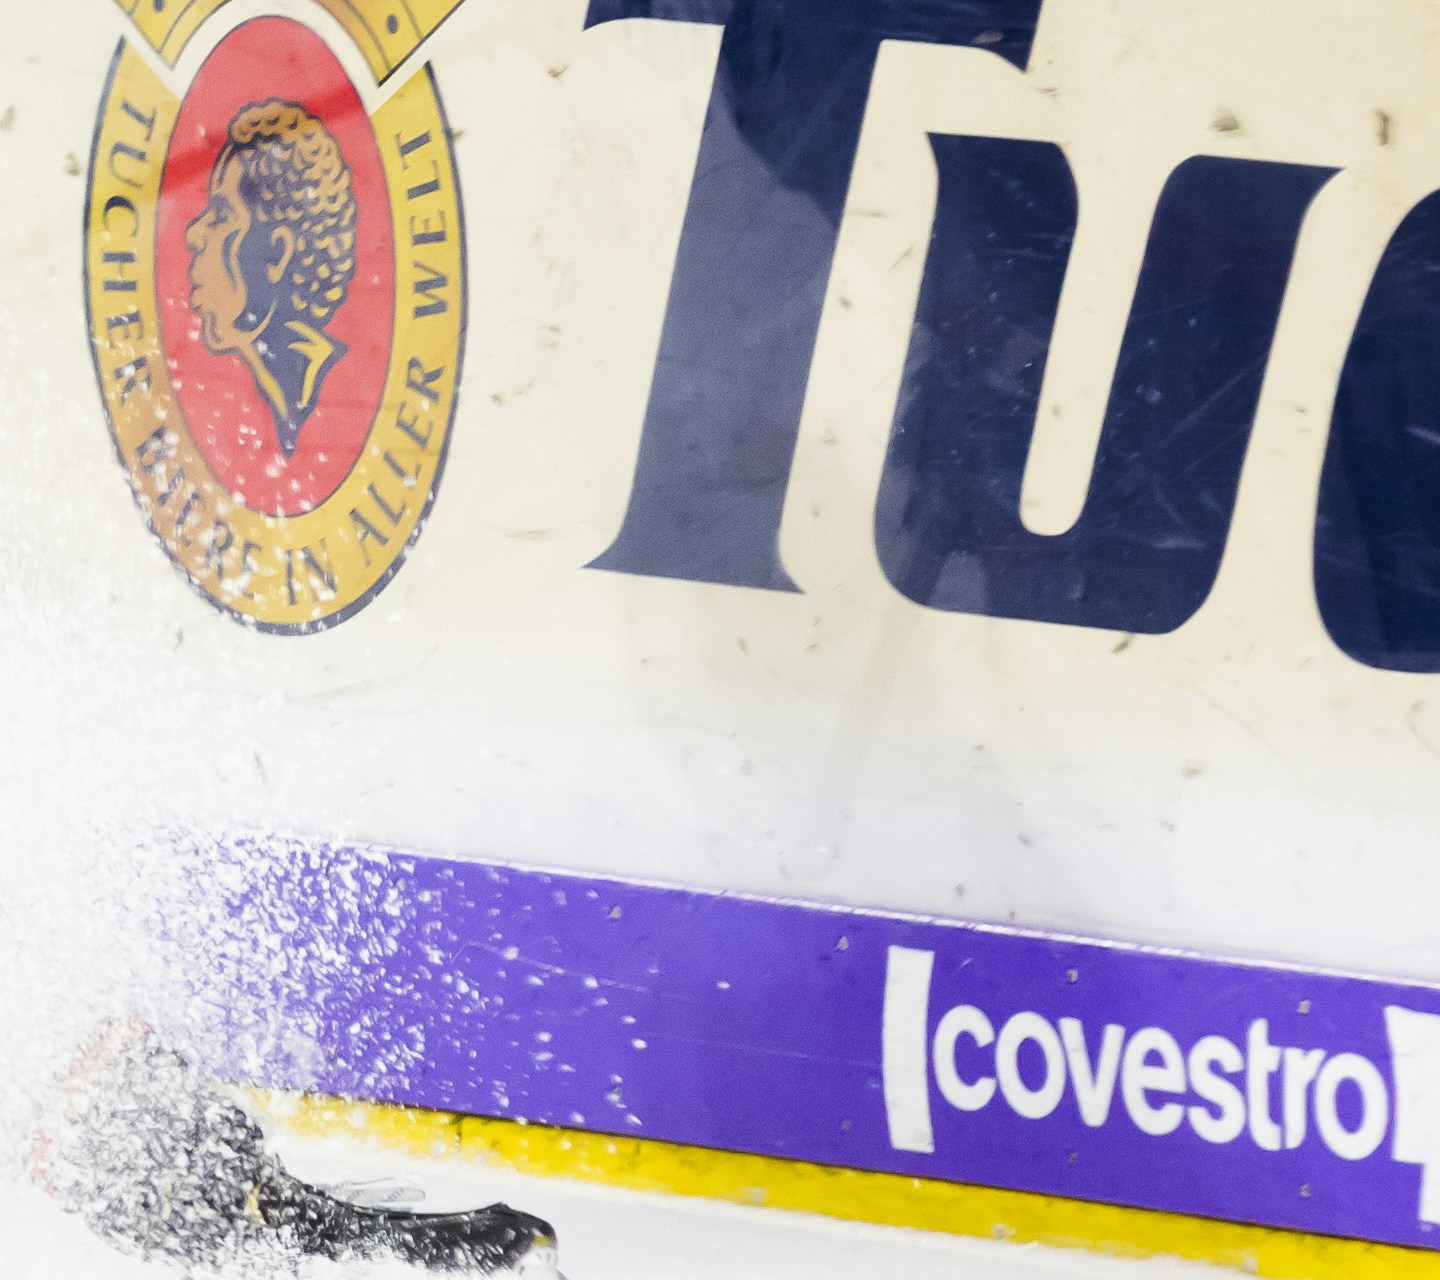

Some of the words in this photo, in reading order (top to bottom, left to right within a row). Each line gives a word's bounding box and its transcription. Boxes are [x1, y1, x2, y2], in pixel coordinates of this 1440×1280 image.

[101, 97, 158, 407] TUCHER
[285, 537, 339, 607] IN
[347, 354, 446, 568] ALLER
[397, 128, 451, 321] WELT
[933, 1004, 1388, 1162] covestro
